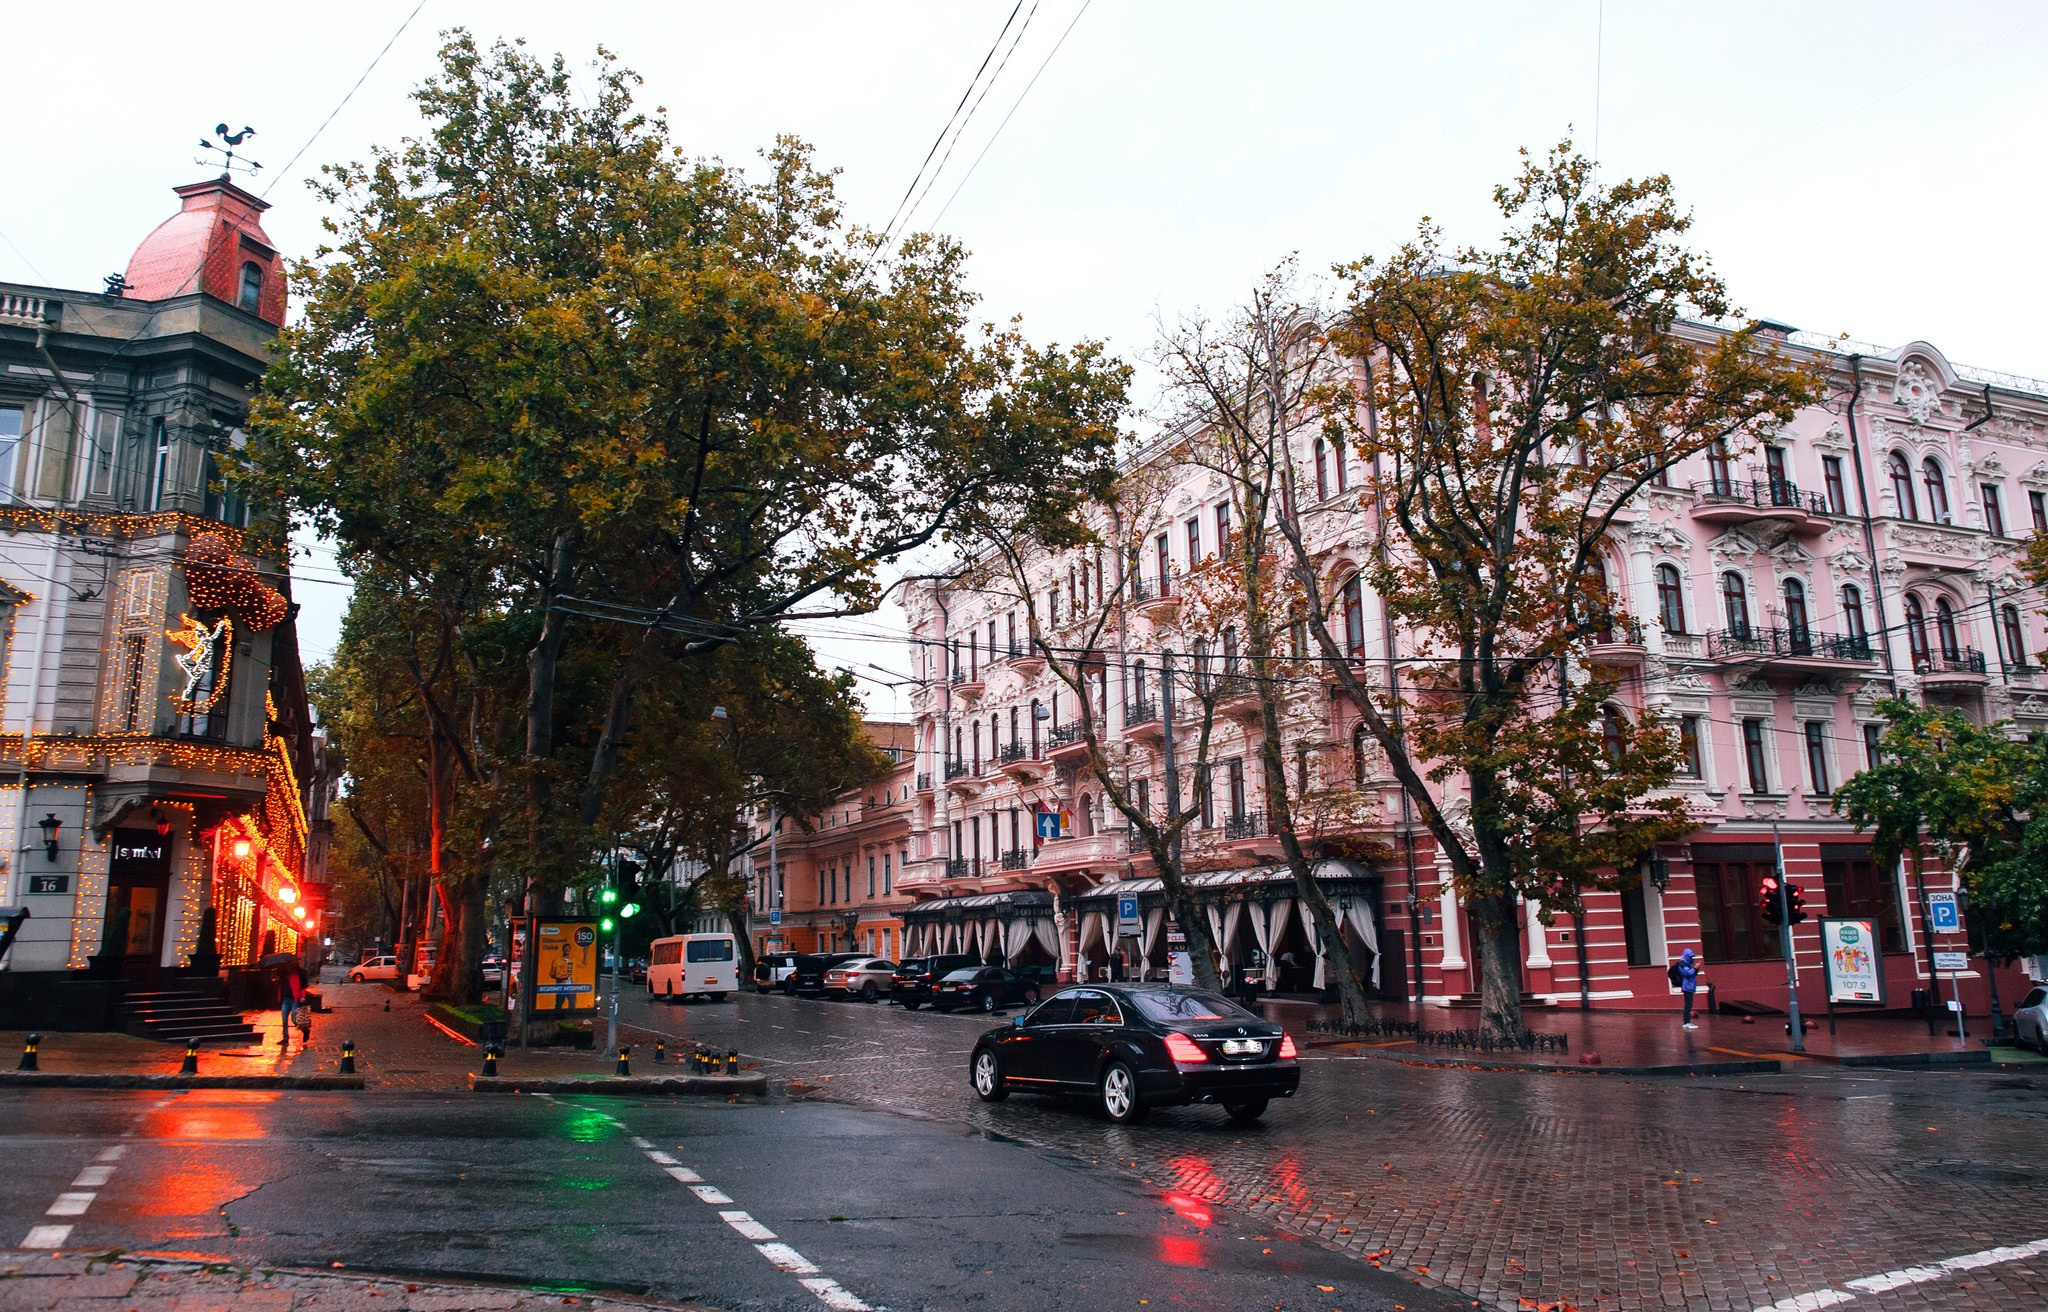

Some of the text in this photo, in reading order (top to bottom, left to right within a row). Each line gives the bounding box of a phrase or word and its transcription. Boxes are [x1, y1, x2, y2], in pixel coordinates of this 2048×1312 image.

[41, 881, 56, 891] 16
[1124, 902, 1132, 915] P
[1938, 907, 1950, 922] P
[577, 932, 593, 940] 150
[1843, 981, 1866, 989] 107.9
